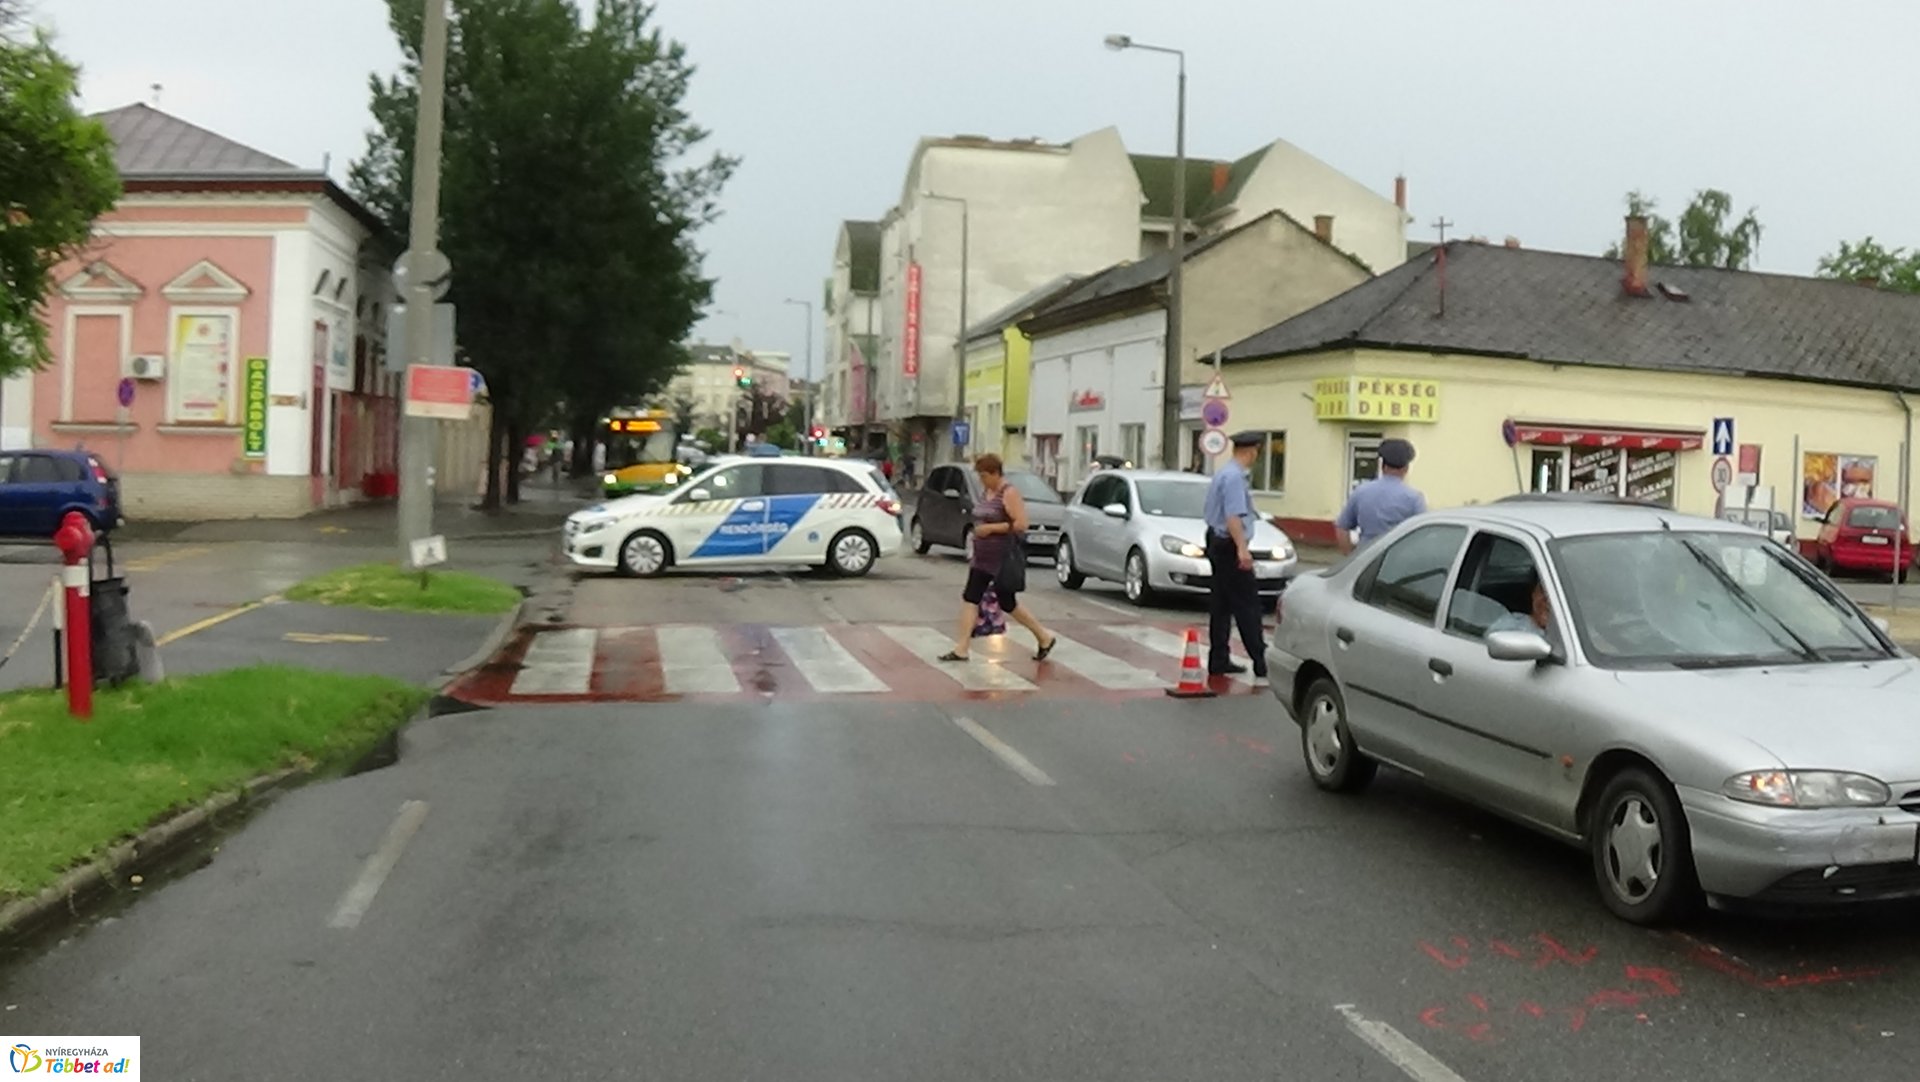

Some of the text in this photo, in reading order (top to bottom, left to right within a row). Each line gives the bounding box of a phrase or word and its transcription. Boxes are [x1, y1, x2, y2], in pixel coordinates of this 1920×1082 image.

[1358, 380, 1436, 397] PÉKSÉG
[249, 360, 265, 450] GAZDABOLT
[1359, 400, 1433, 418] DIBRI
